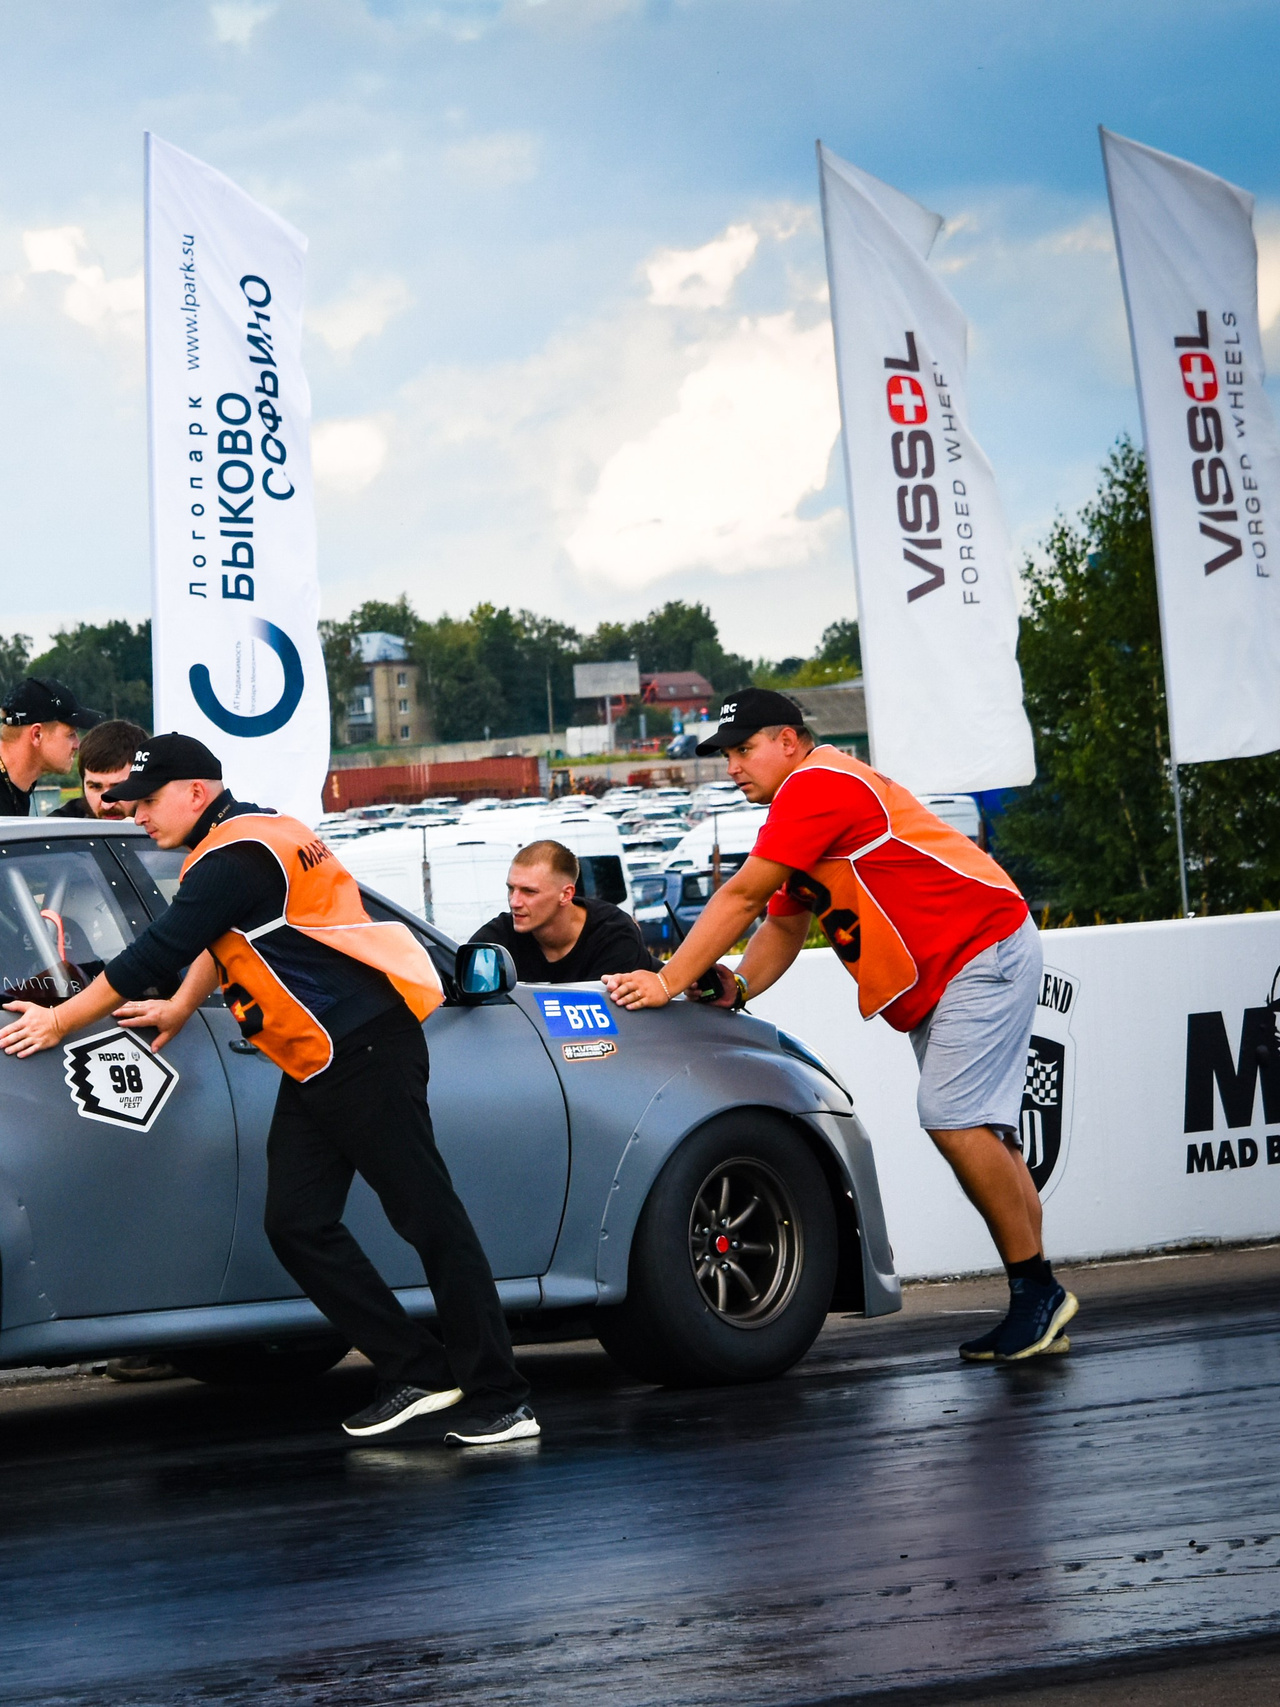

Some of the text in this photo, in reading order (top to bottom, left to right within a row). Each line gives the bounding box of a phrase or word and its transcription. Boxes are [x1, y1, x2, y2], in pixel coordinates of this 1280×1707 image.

[179, 233, 209, 599] Логопарк www.lpark.su
[239, 274, 296, 501] СОФЬИНО
[1222, 311, 1246, 439] WHEELS
[216, 392, 255, 602] БЫКОВО
[883, 331, 946, 604] VISSOL
[1173, 310, 1243, 577] VISSOL
[952, 480, 981, 605] FORGED
[98, 1052, 126, 1062] RDRC
[109, 1064, 144, 1094] 98
[562, 1004, 610, 1030] ВТБ
[1185, 1137, 1259, 1175] MAD
